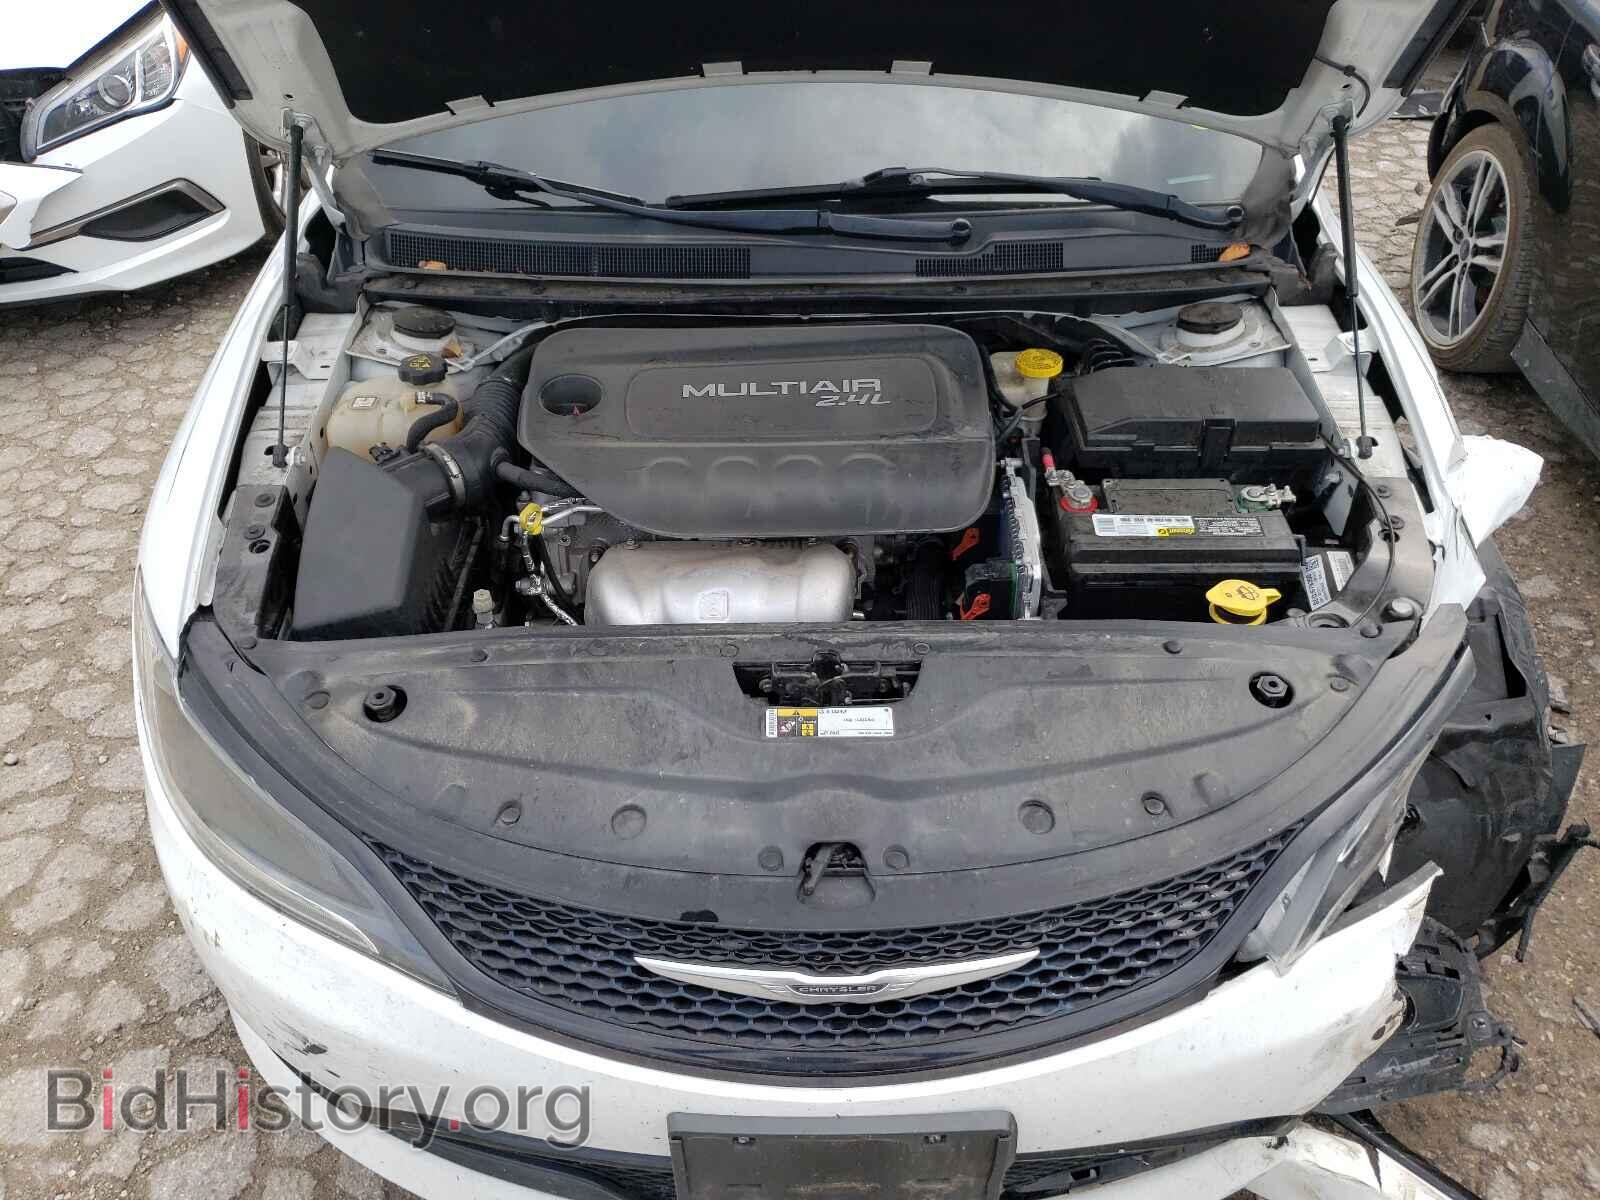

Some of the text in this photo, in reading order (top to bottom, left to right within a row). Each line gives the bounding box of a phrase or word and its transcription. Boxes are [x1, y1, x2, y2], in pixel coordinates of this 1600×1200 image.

[682, 378, 881, 398] MULTIAIR
[815, 393, 891, 407] 2.4L
[799, 985, 878, 993] CHRYSLER
